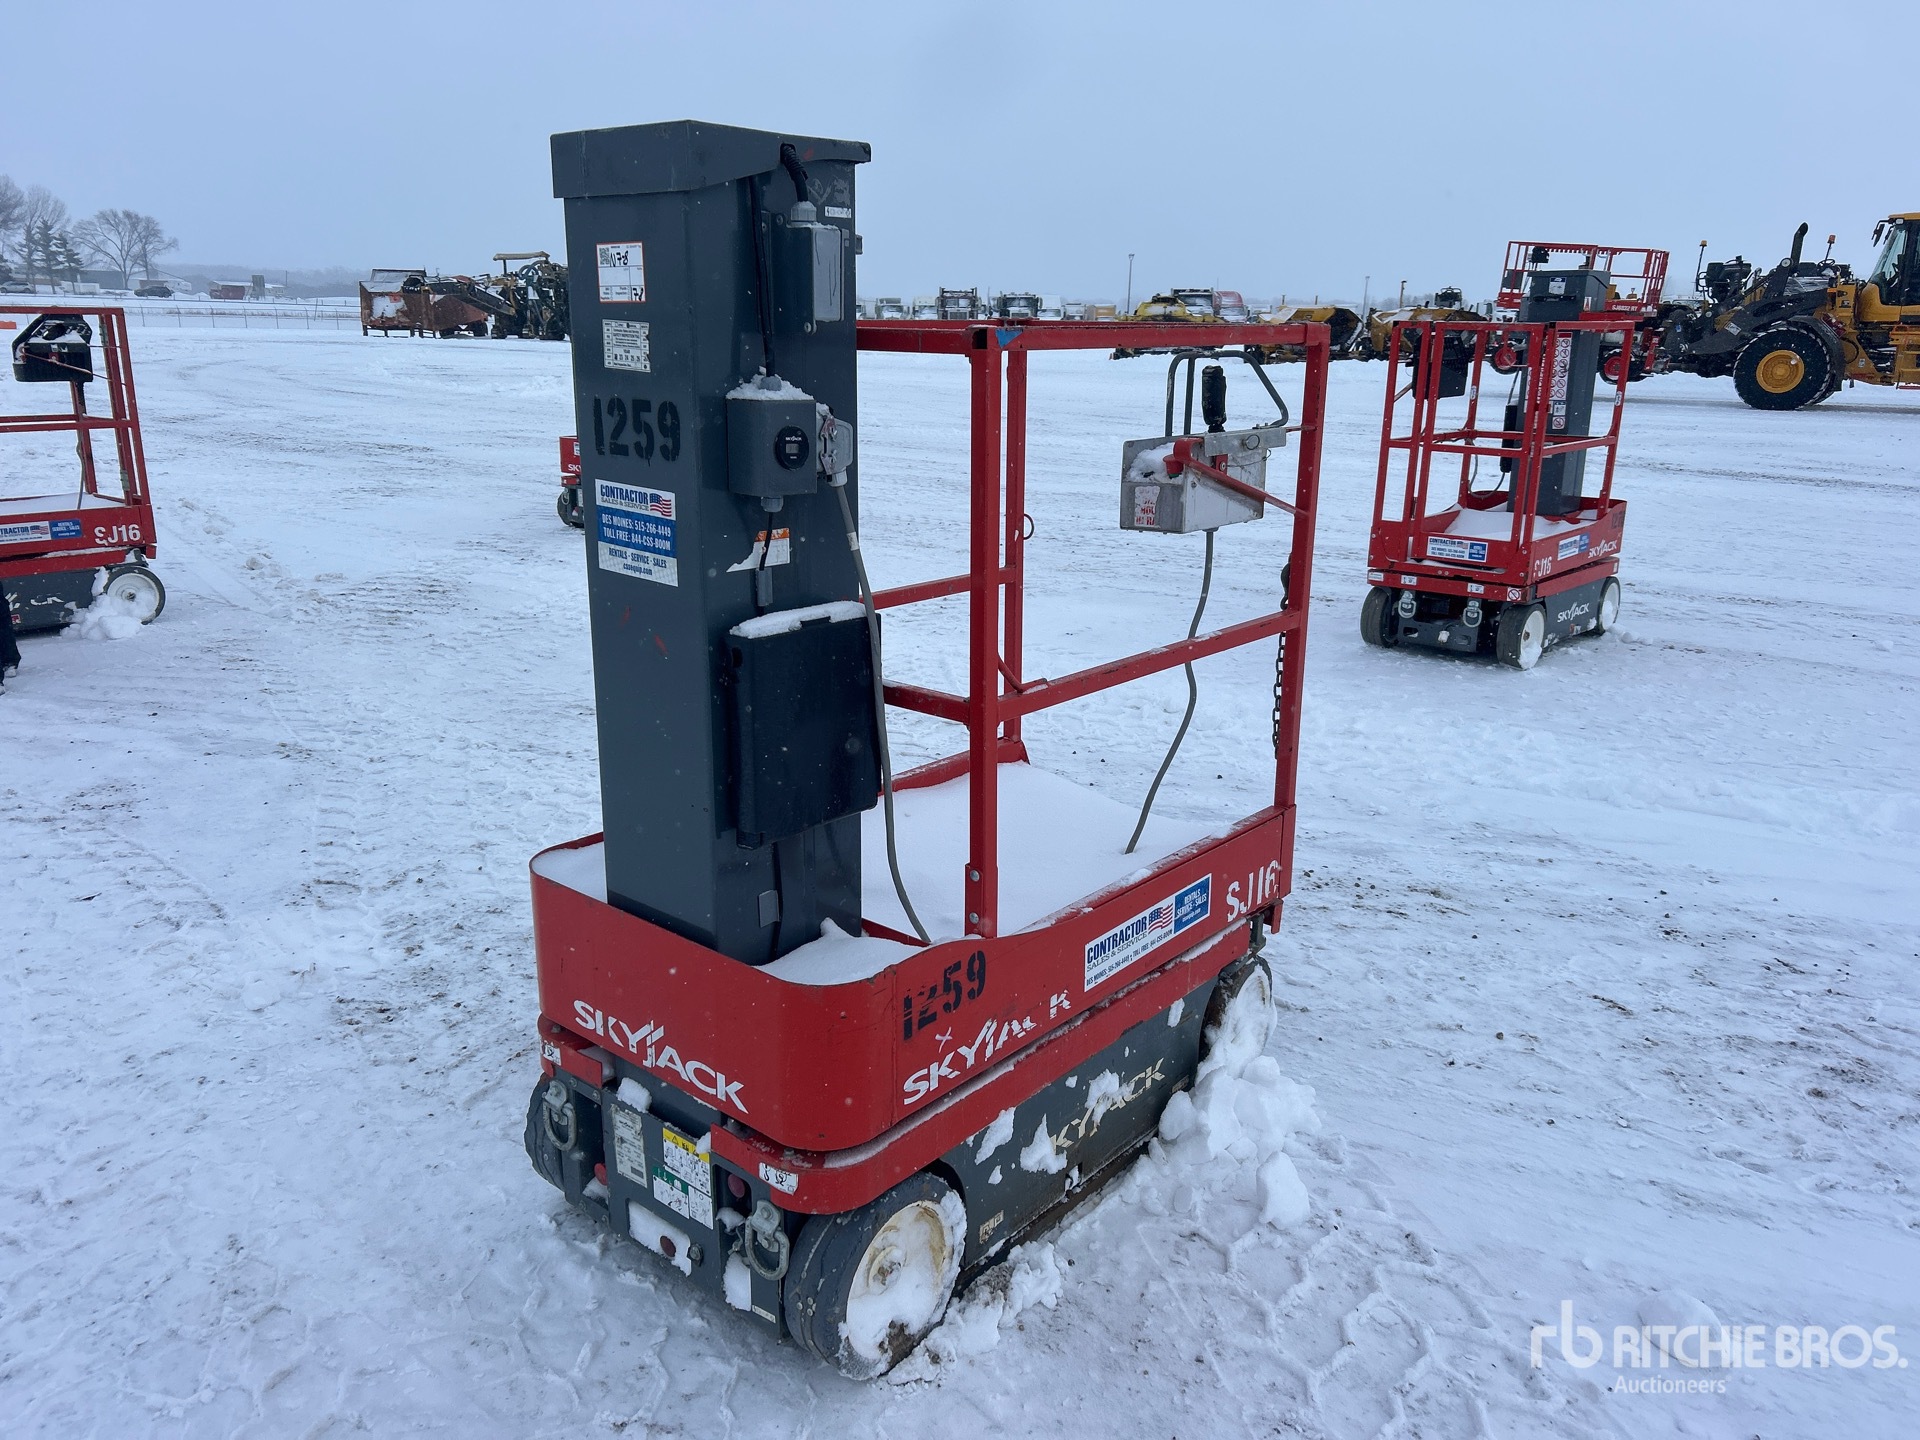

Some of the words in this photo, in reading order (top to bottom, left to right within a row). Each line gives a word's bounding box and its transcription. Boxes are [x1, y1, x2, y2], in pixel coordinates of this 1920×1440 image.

[593, 396, 681, 463] 1259
[600, 484, 649, 505] CONTRACTOR
[601, 497, 618, 506] SALES
[94, 524, 141, 546] SJ16
[602, 513, 612, 525] DES
[612, 516, 634, 530] MOINES:
[634, 520, 672, 537] 515-266-4449
[603, 527, 616, 539] TOLL
[616, 530, 631, 542] FREE:
[631, 535, 671, 551] 844-CSS-BOOM
[608, 547, 628, 560] RENTALS
[631, 552, 650, 565] SERVICE
[653, 557, 667, 569] SALES
[1557, 602, 1590, 623] SKYJACK
[1086, 915, 1148, 964] CONTRACTOR
[1086, 952, 1111, 972] SALES
[1116, 931, 1149, 954] SERVICE
[903, 949, 986, 1041] 1259
[573, 1000, 748, 1114] SKYJACK
[903, 990, 1072, 1105] SKYJAK
